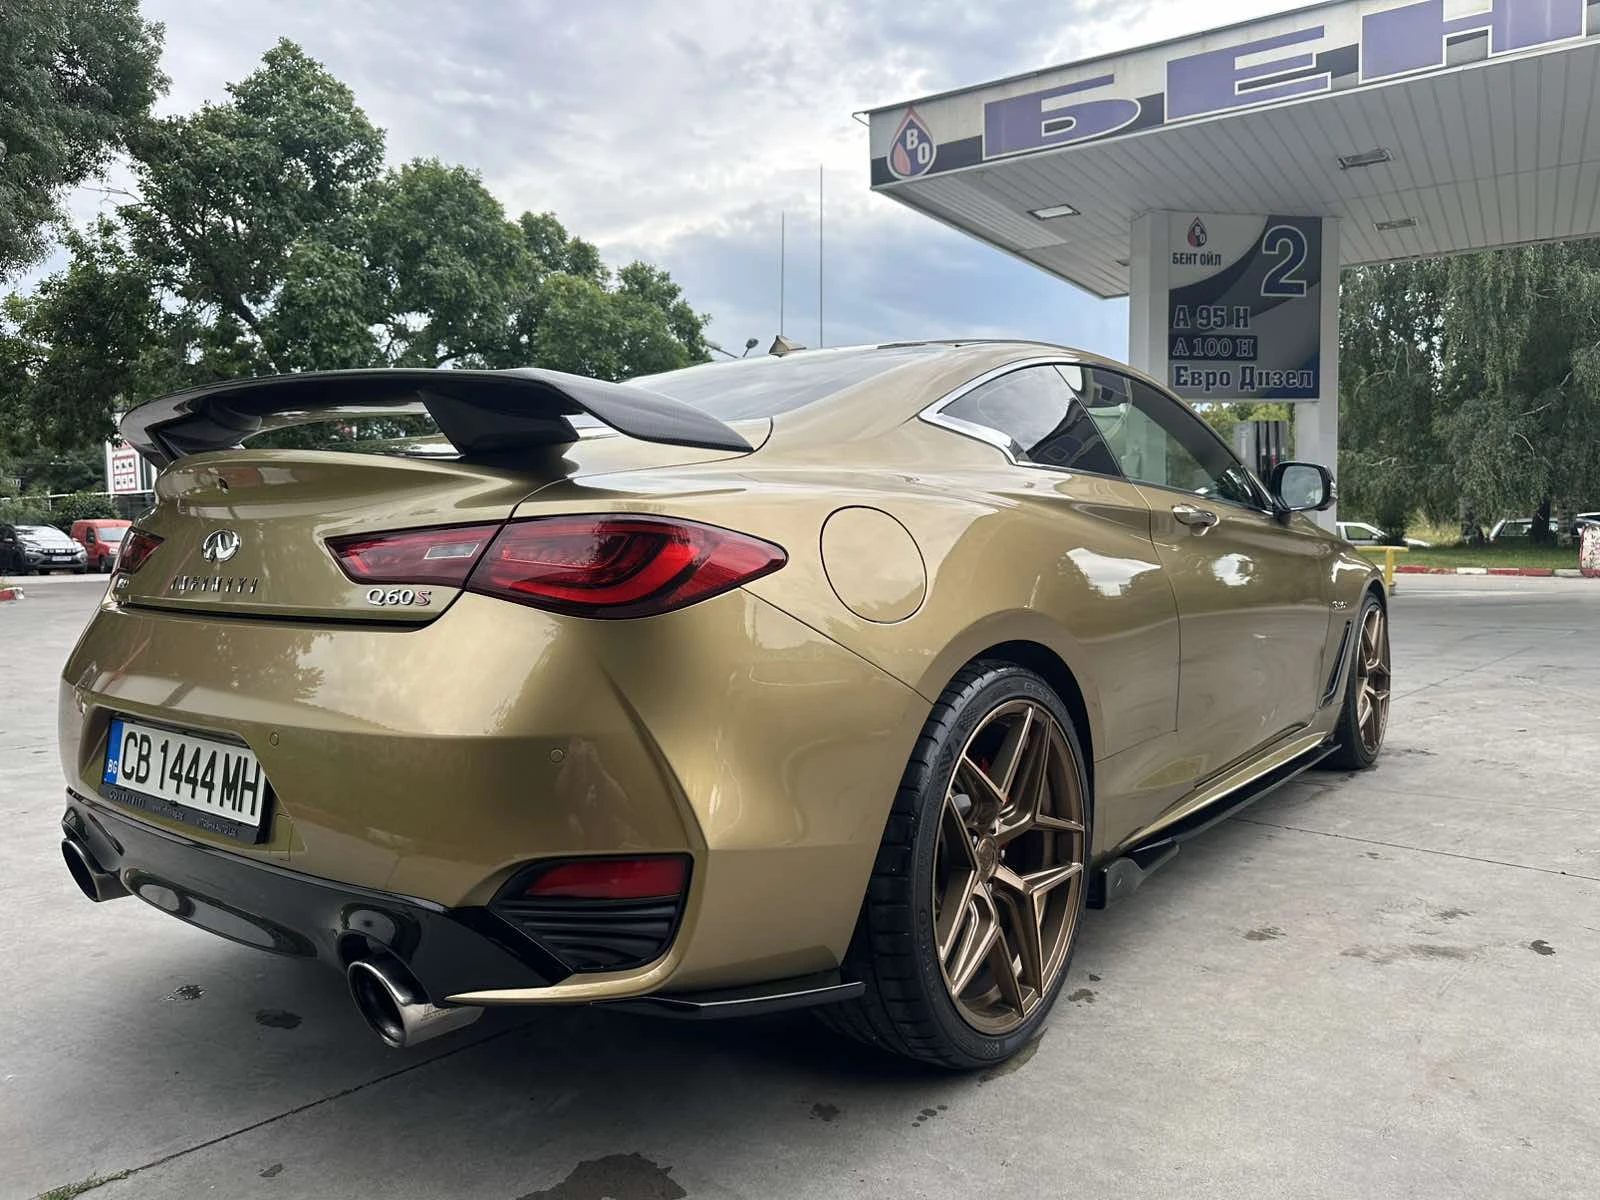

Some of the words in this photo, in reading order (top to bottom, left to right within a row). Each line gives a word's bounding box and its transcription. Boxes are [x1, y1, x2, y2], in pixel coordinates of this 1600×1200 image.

[1172, 252, 1198, 266] БЕНТ
[1200, 251, 1222, 266] ОЙЛ
[1260, 224, 1308, 297] 2
[1197, 305, 1227, 330] 95
[1193, 337, 1233, 357] 100
[1173, 364, 1232, 392] Евро
[1238, 364, 1313, 392] Дизел
[366, 588, 432, 606] Q60S
[107, 758, 119, 775] BG
[121, 731, 152, 785] CB
[159, 738, 217, 804] 1444
[218, 752, 261, 816] MH
